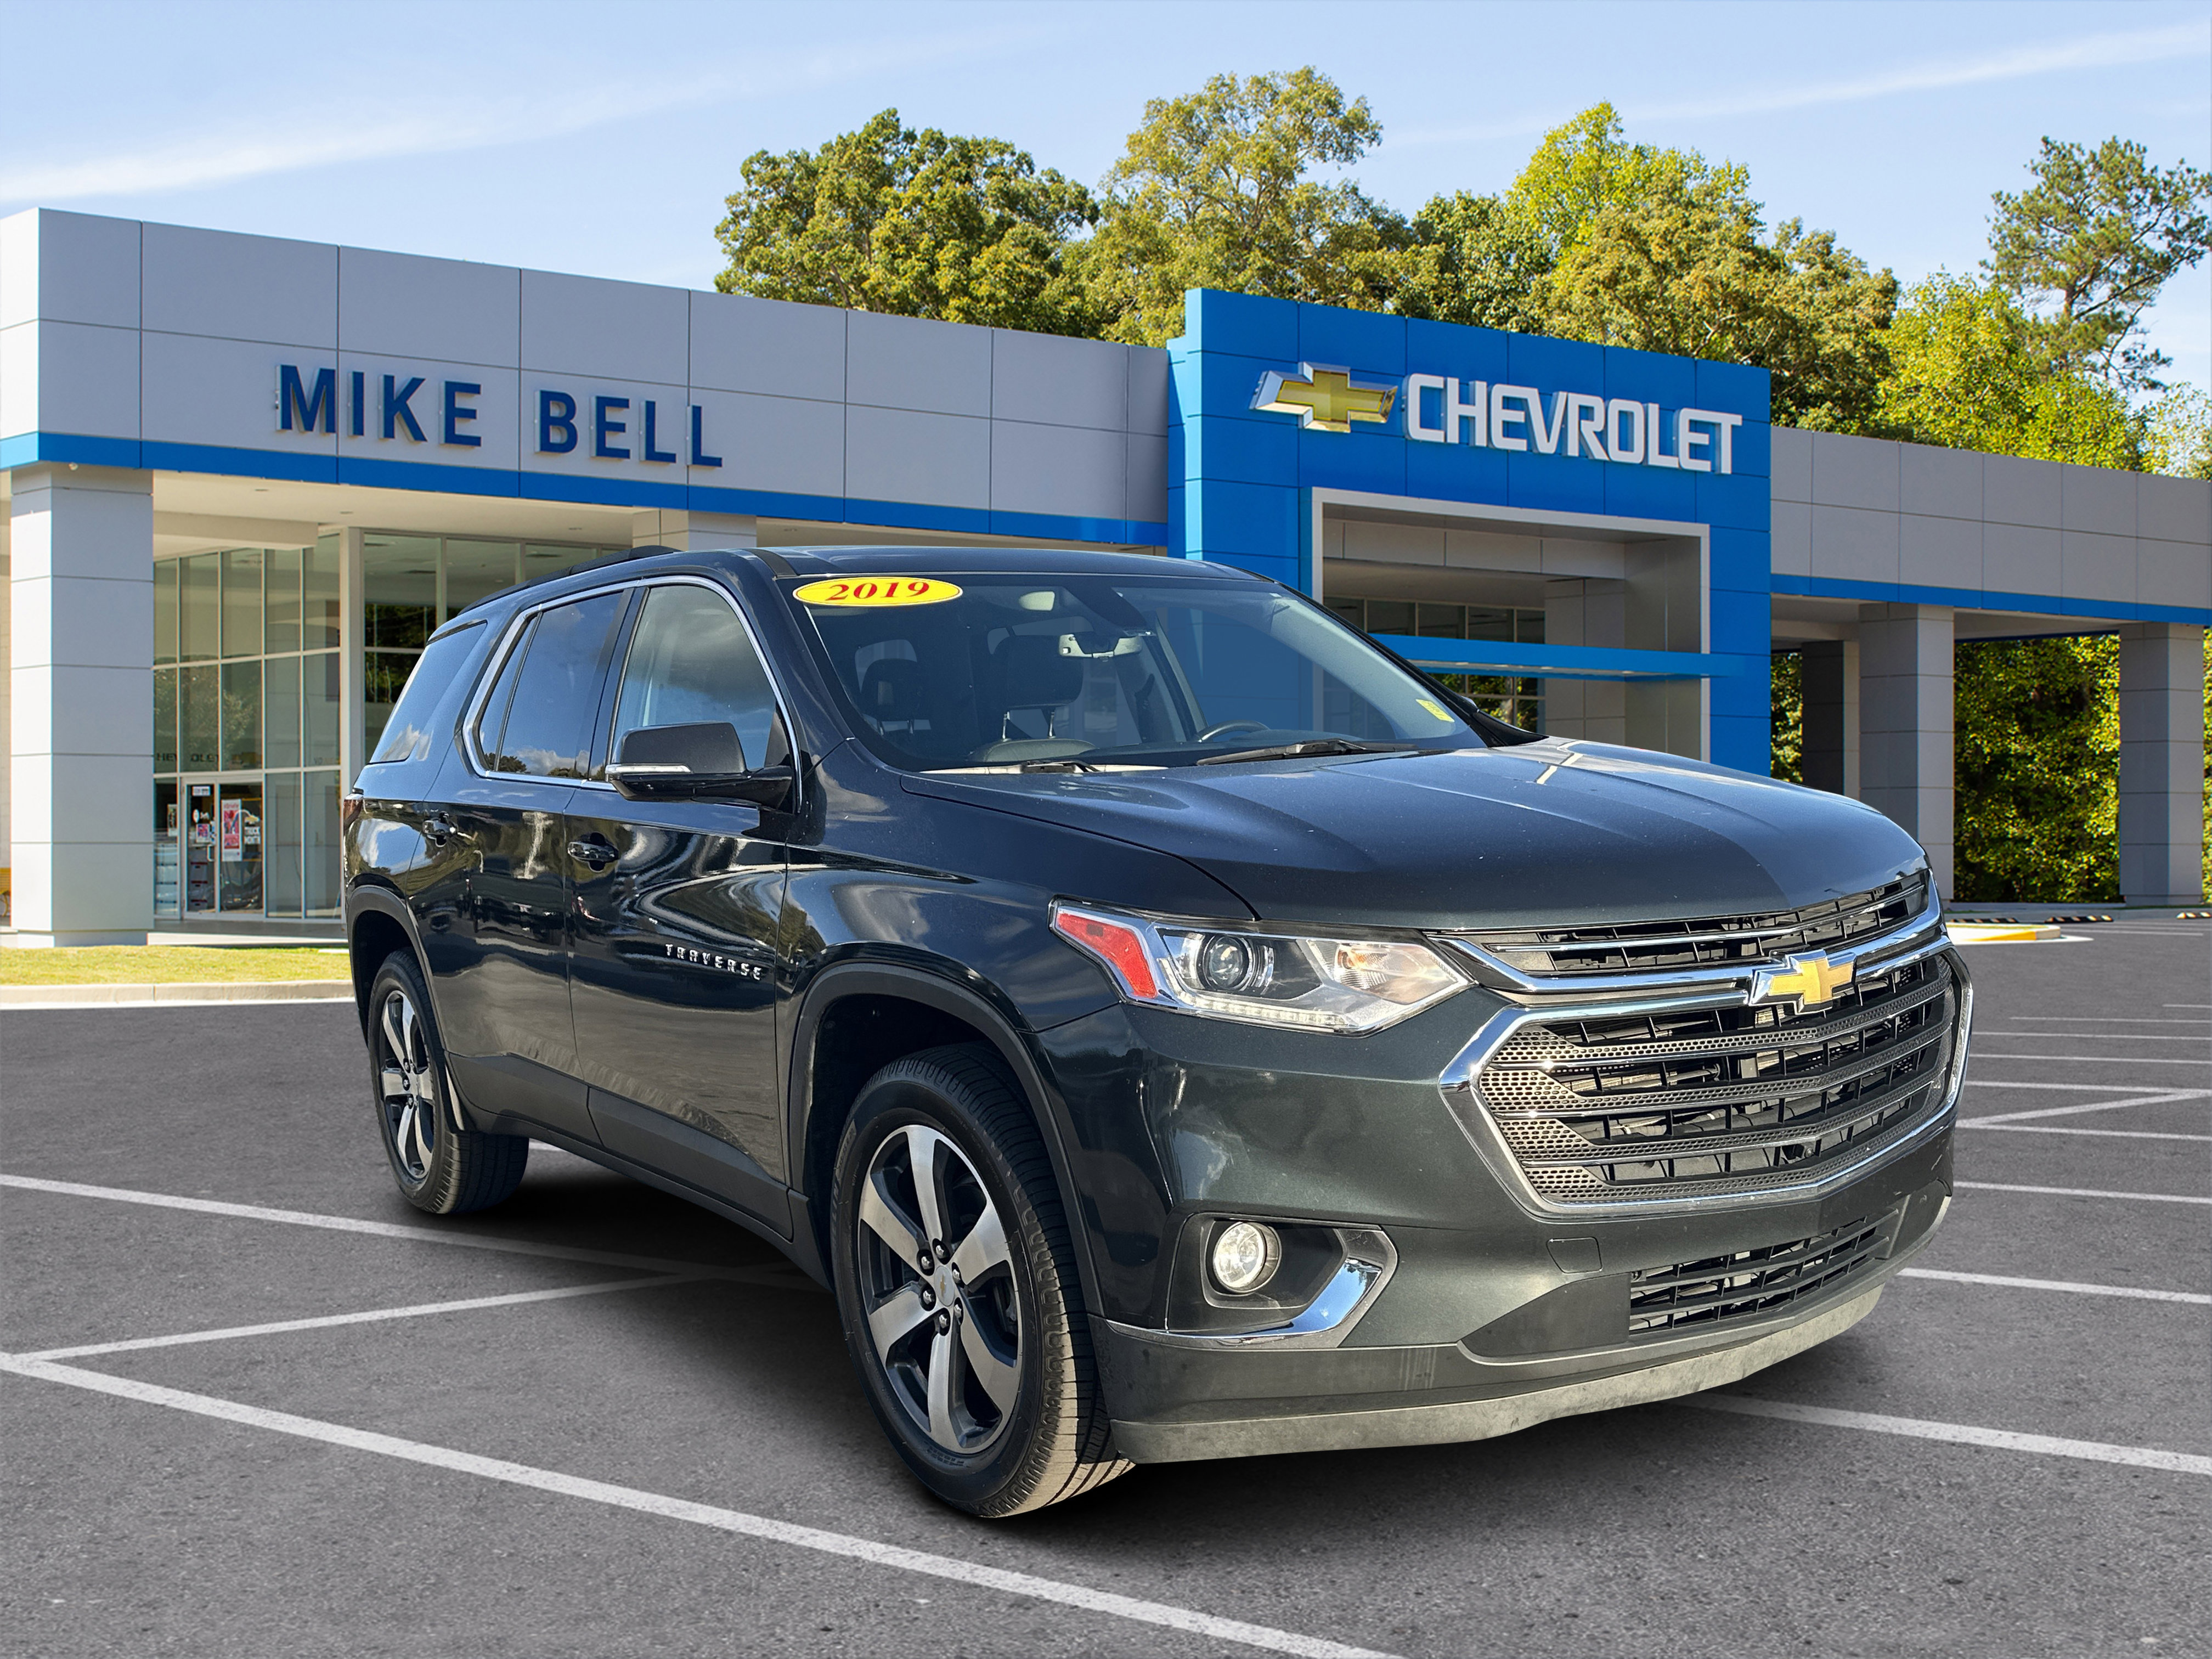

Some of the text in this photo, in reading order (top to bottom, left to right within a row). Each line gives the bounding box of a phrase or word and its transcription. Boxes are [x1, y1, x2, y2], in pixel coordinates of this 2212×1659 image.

[278, 364, 724, 469] MIKE BELL
[1403, 373, 1743, 475] CHEVROLET
[825, 582, 929, 601] 2019
[665, 944, 762, 981] TRAVERSE
